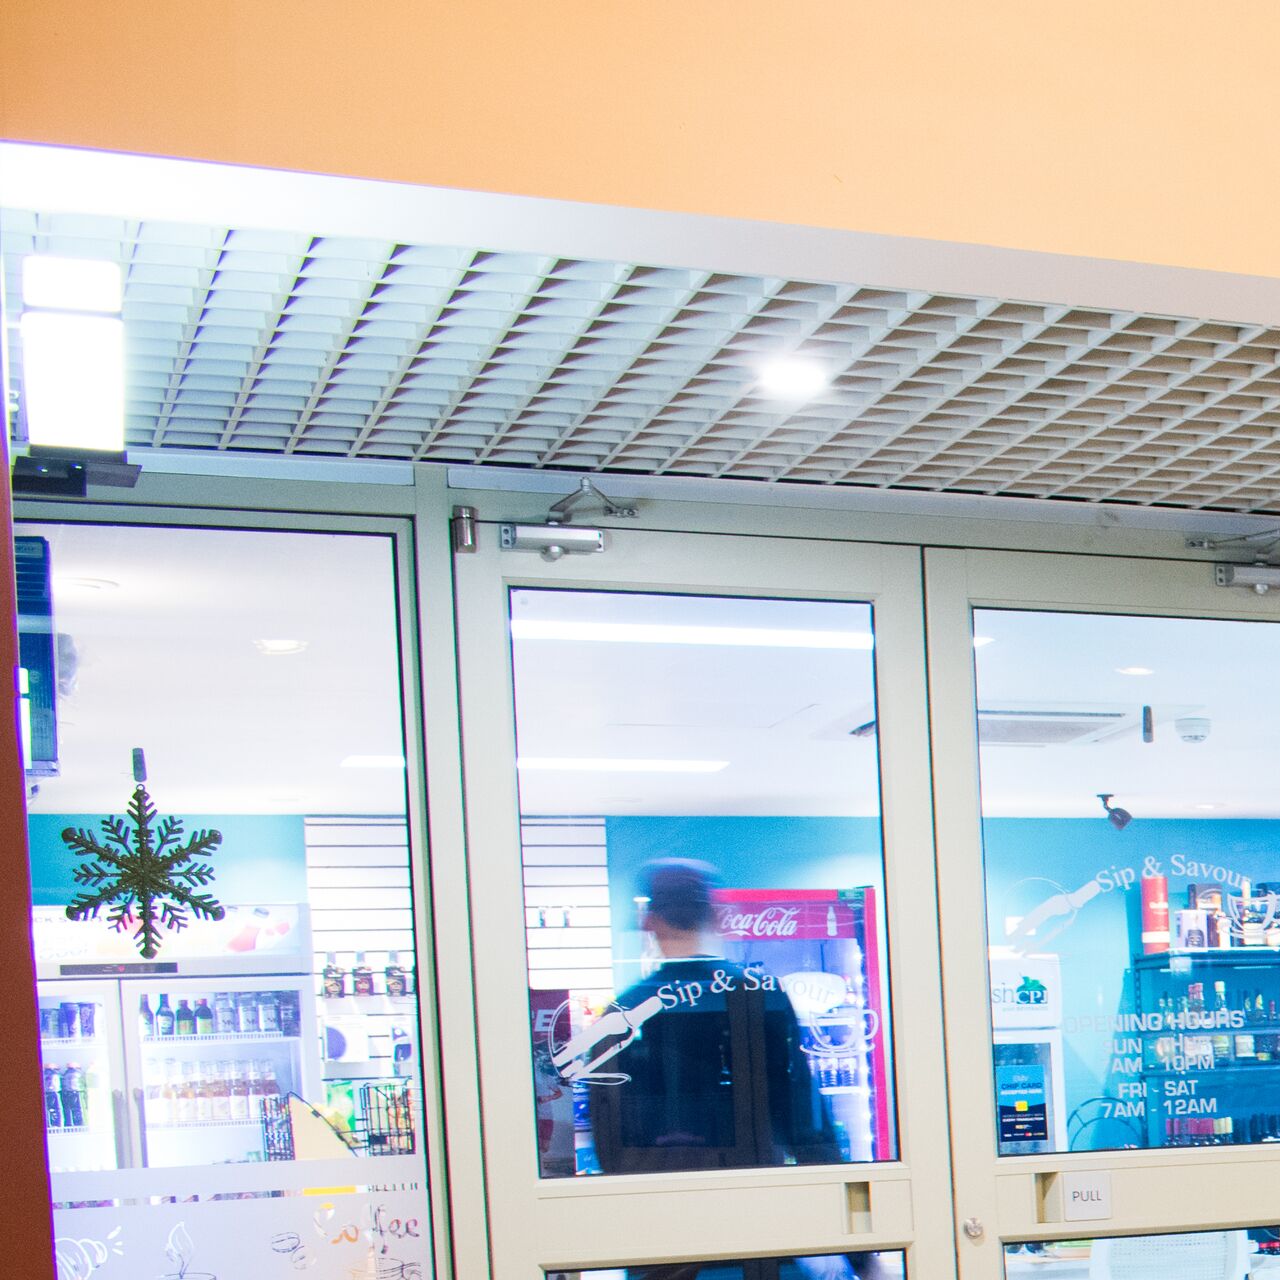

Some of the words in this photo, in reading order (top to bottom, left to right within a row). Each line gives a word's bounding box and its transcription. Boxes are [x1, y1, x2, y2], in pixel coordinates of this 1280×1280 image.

[1096, 865, 1135, 893] Sip
[1141, 856, 1163, 878] &
[1170, 854, 1252, 890] Savour
[656, 979, 702, 1010] Sip
[710, 969, 736, 993] &
[1063, 1012, 1163, 1033] OPENING
[1170, 1010, 1245, 1031] HOURS
[1163, 1055, 1215, 1071] 10PM
[1117, 1083, 1147, 1098] FRI
[1164, 1080, 1199, 1096] SAT
[1101, 1101, 1145, 1118] 7AM
[1163, 1098, 1217, 1115] 12AM
[1072, 1190, 1102, 1202] PULL
